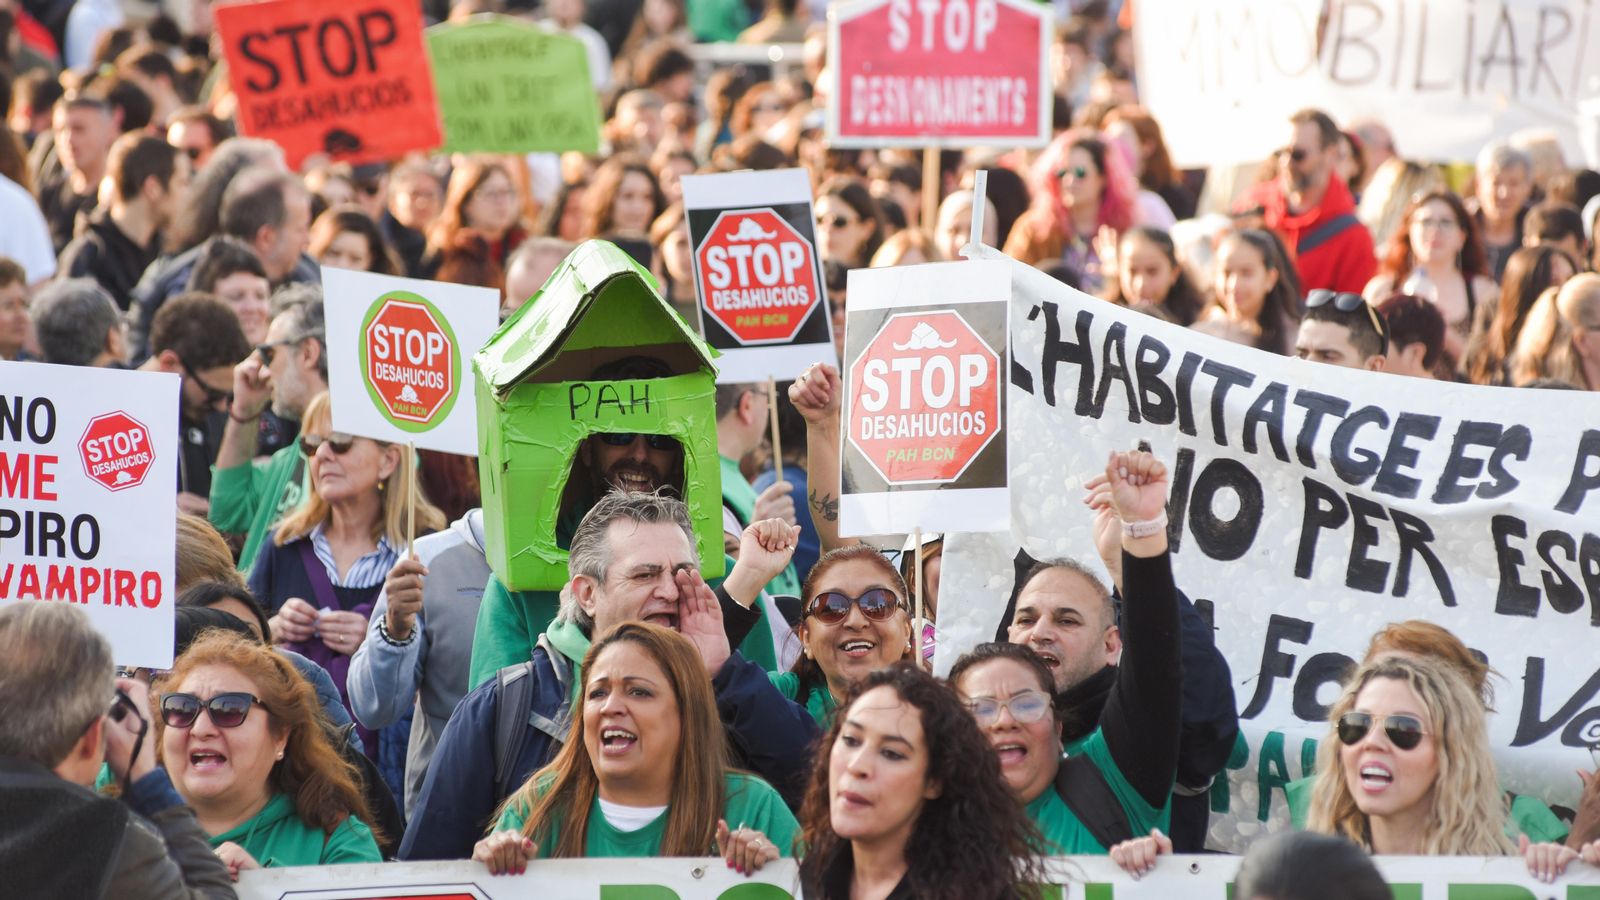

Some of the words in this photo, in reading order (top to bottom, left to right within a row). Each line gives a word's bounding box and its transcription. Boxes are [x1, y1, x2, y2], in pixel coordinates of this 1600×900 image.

[889, 0, 998, 52] STOP
[238, 10, 397, 93] STOP
[252, 76, 413, 131] DESAHUCIOS
[706, 242, 805, 288] STOP
[711, 285, 809, 311] DESAHUCIOS
[736, 315, 760, 327] PAH
[763, 314, 789, 326] BCN
[373, 323, 444, 367] STOP
[375, 362, 444, 390] DESAHUCIOS
[861, 354, 988, 413] STOP
[0, 395, 56, 445] NO
[393, 402, 409, 414] PAH
[411, 405, 427, 417] BCN
[569, 383, 650, 420] PAH
[86, 428, 143, 462] STOP
[861, 410, 986, 441] DESAHUCIOS
[0, 452, 58, 501] ME
[92, 452, 149, 476] DESAHUCIOS
[886, 448, 918, 464] PAH
[921, 447, 956, 462] BCN
[0, 509, 100, 561] PIRO
[1294, 476, 1458, 607] PER
[0, 563, 162, 608] VAMPIRO
[1211, 730, 1318, 822] PA
